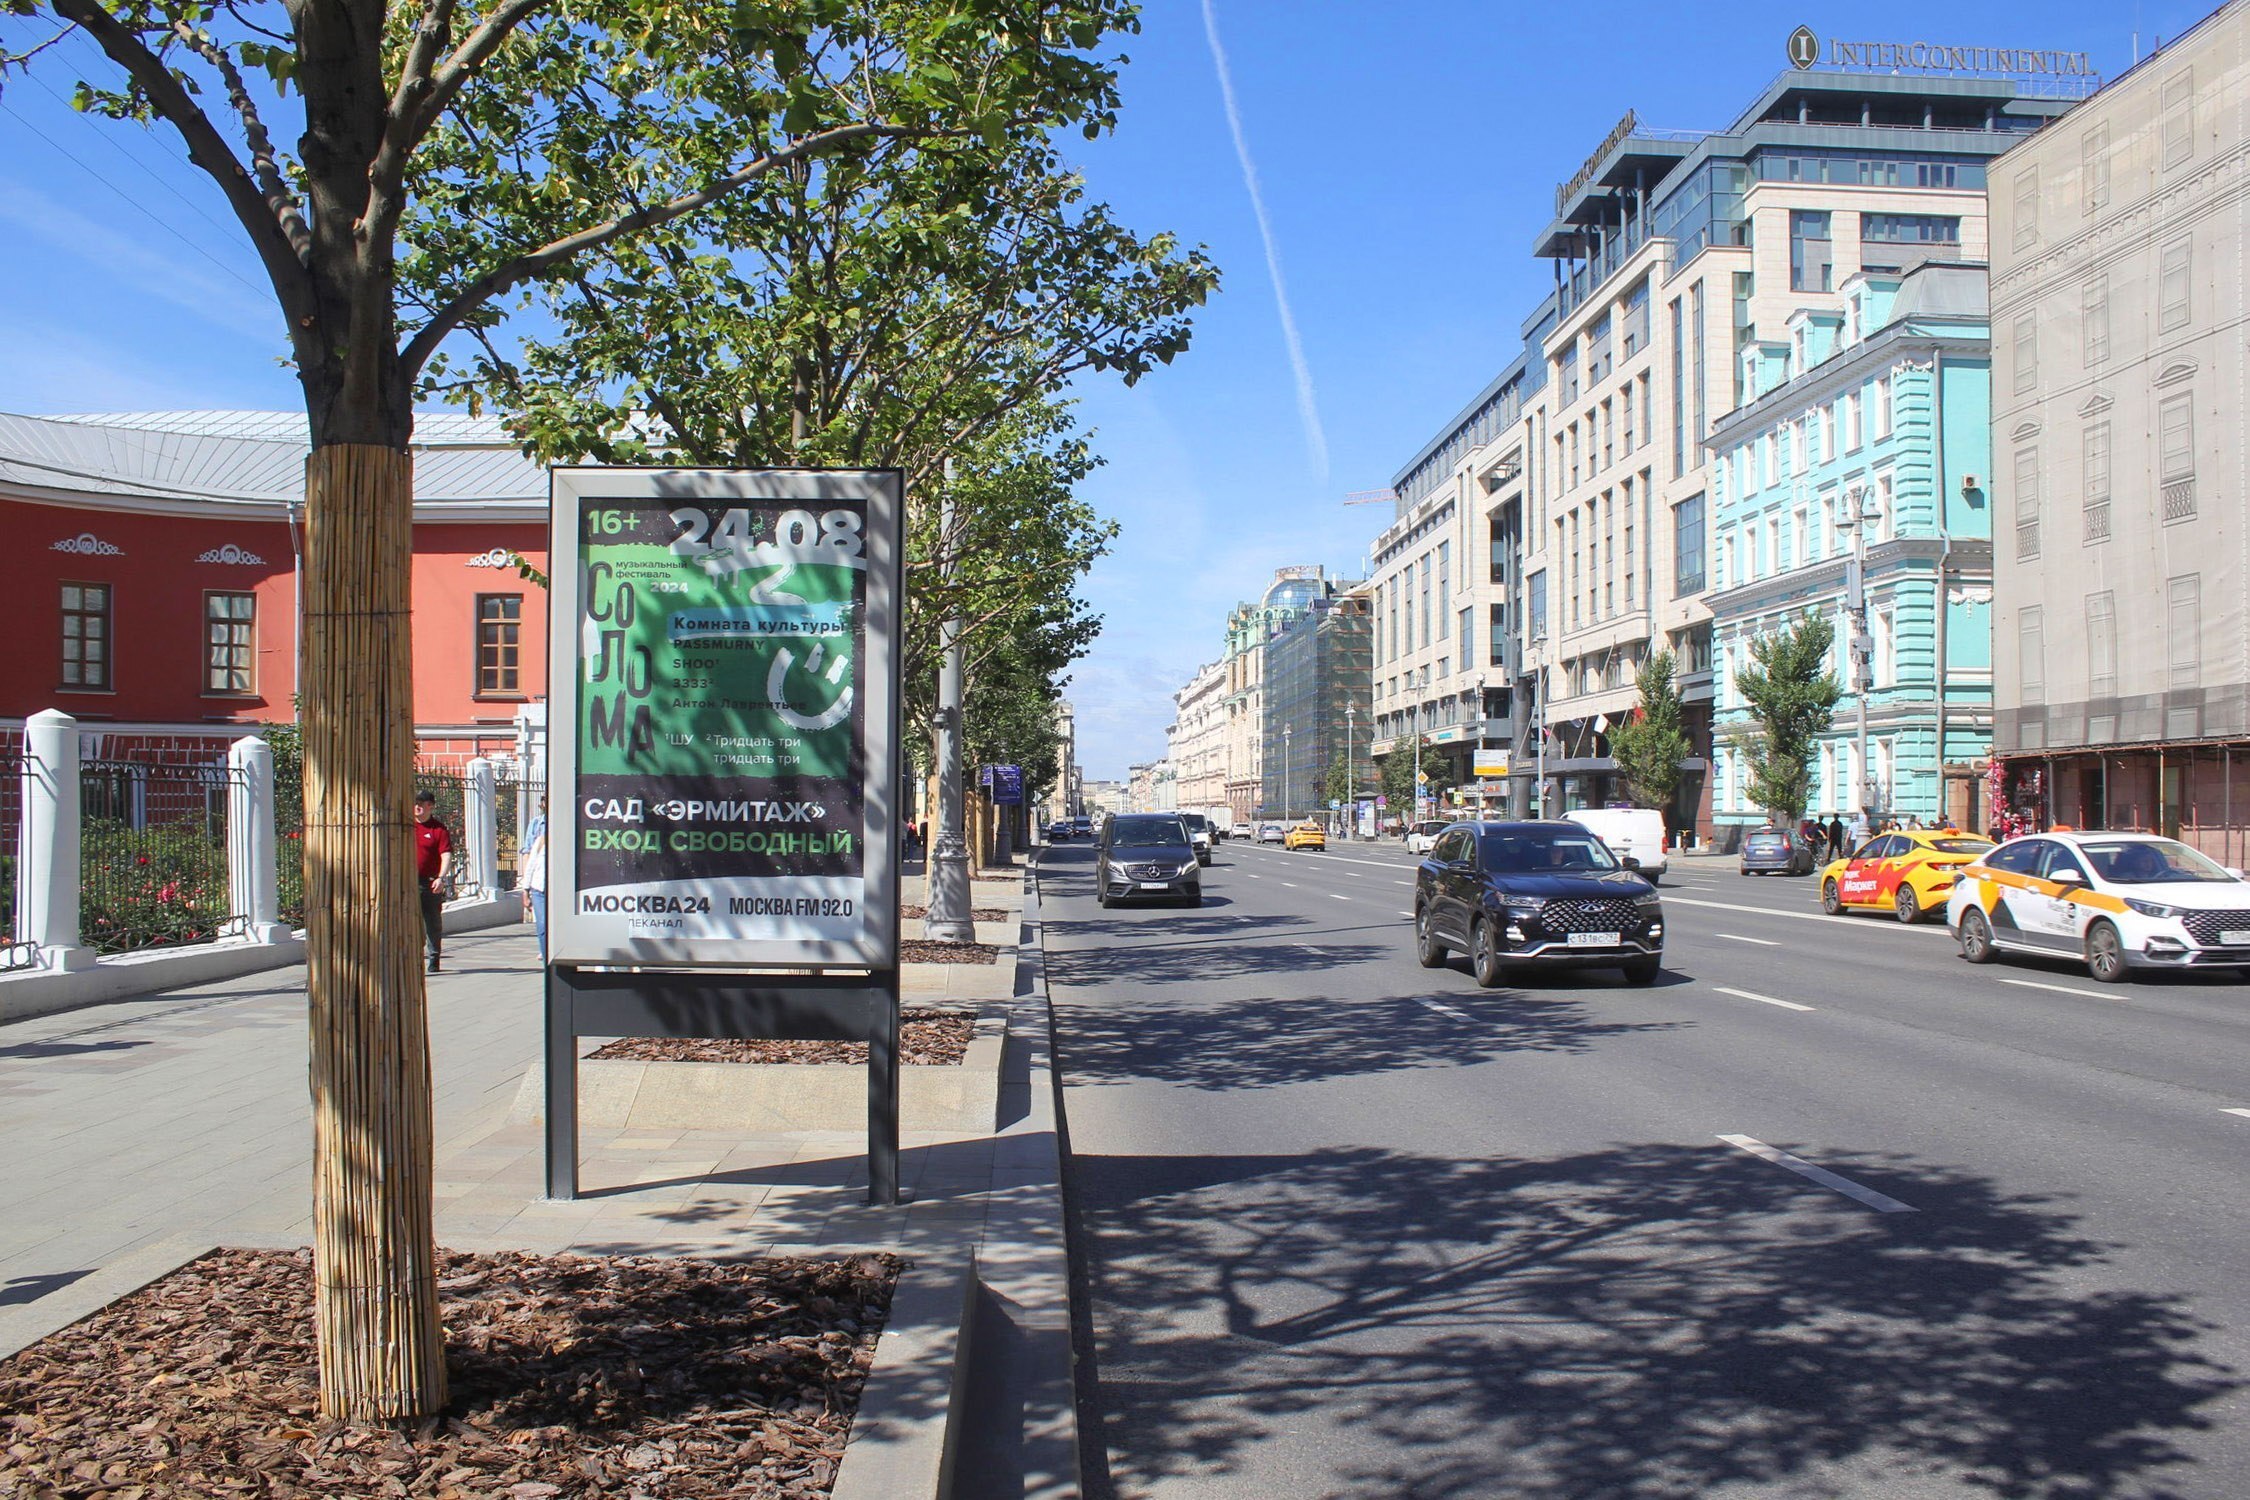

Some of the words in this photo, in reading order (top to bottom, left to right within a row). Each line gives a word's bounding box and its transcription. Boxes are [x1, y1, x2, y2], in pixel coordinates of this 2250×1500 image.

[588, 509, 641, 535] 16+
[615, 561, 688, 569] музыкальный
[615, 571, 671, 579] фестиваль
[650, 582, 689, 593] 2024
[674, 617, 750, 630] Комната
[758, 620, 846, 633] культуры
[673, 640, 765, 650] PASSMURNY
[672, 699, 715, 709] Антон
[779, 738, 800, 747] три
[714, 754, 774, 764] тридцать
[778, 755, 800, 764] три
[584, 798, 645, 823] САД
[652, 800, 826, 823] «ЭРМИТАЖ»
[585, 829, 661, 854] ВХОД
[669, 829, 853, 856] СВОБОДНЫЙ
[1844, 880, 1877, 893] Маркет
[583, 895, 710, 914] МОСКВА24
[729, 898, 793, 915] МОСКВА
[796, 899, 819, 916] FM
[822, 899, 853, 917] 92.0
